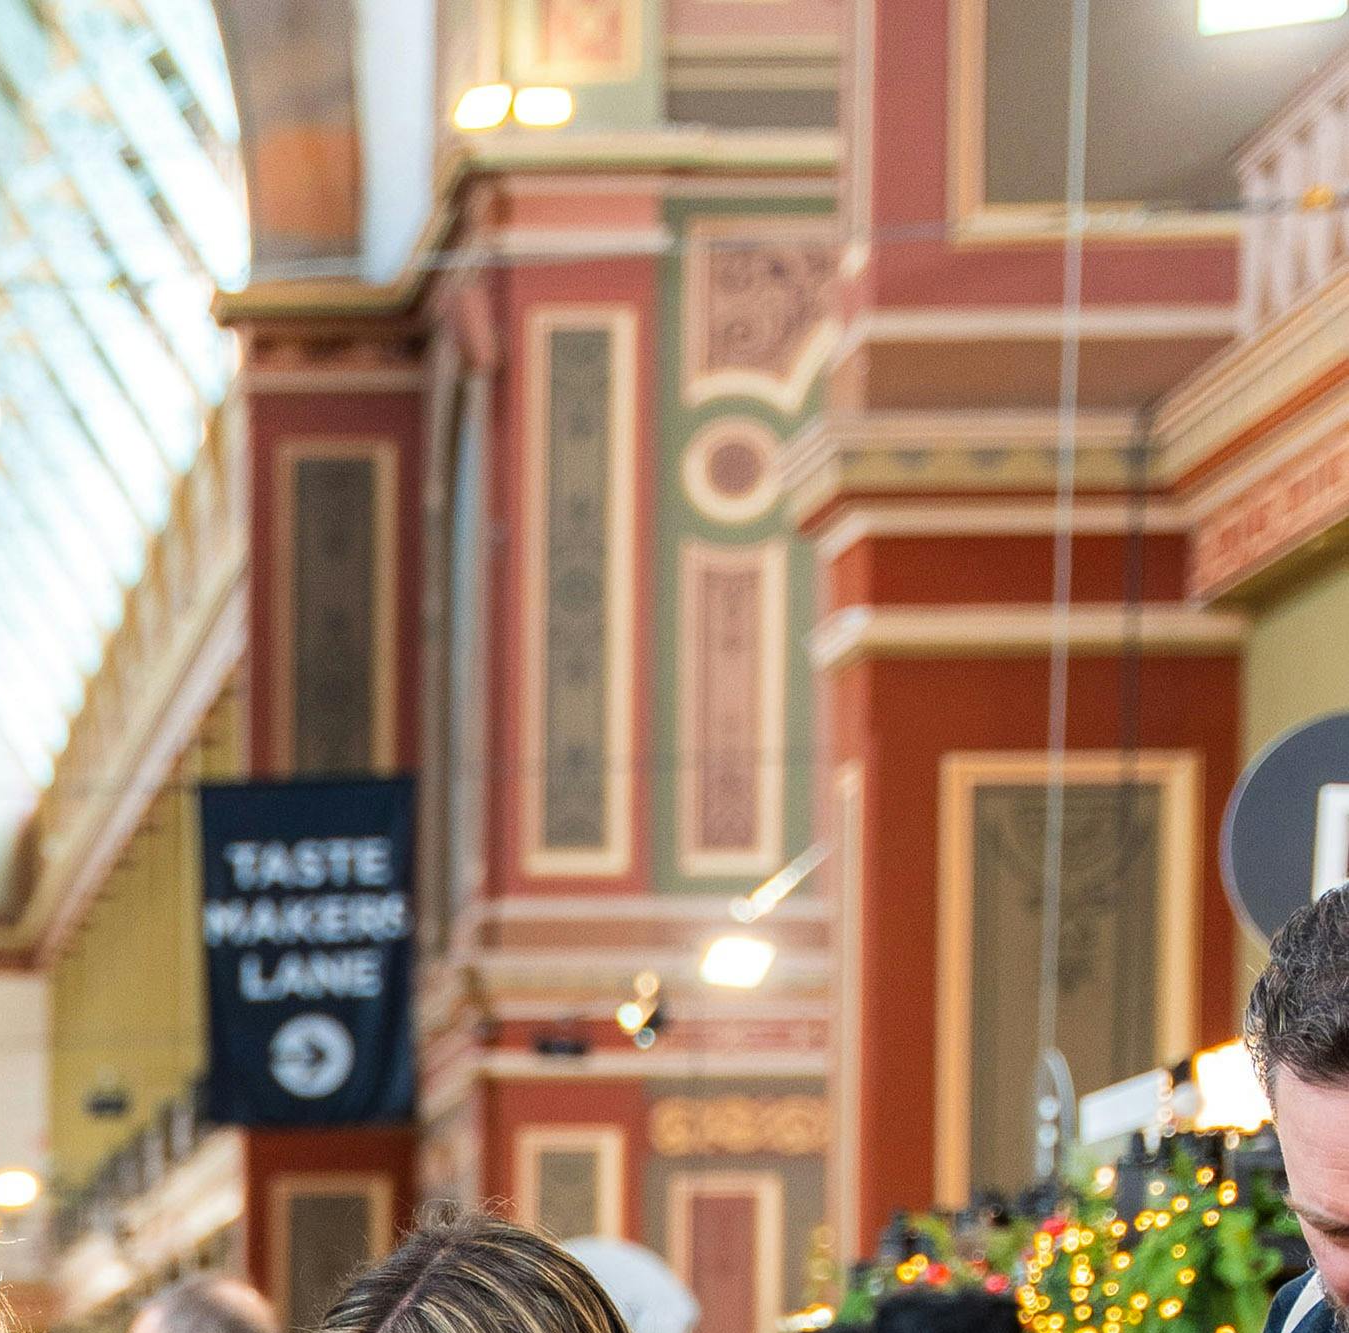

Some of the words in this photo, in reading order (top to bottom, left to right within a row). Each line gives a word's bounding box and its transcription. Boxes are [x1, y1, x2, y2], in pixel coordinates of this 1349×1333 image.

[223, 836, 394, 890] TASTE
[205, 894, 411, 946] MAKERS
[239, 950, 383, 1001] LANE
